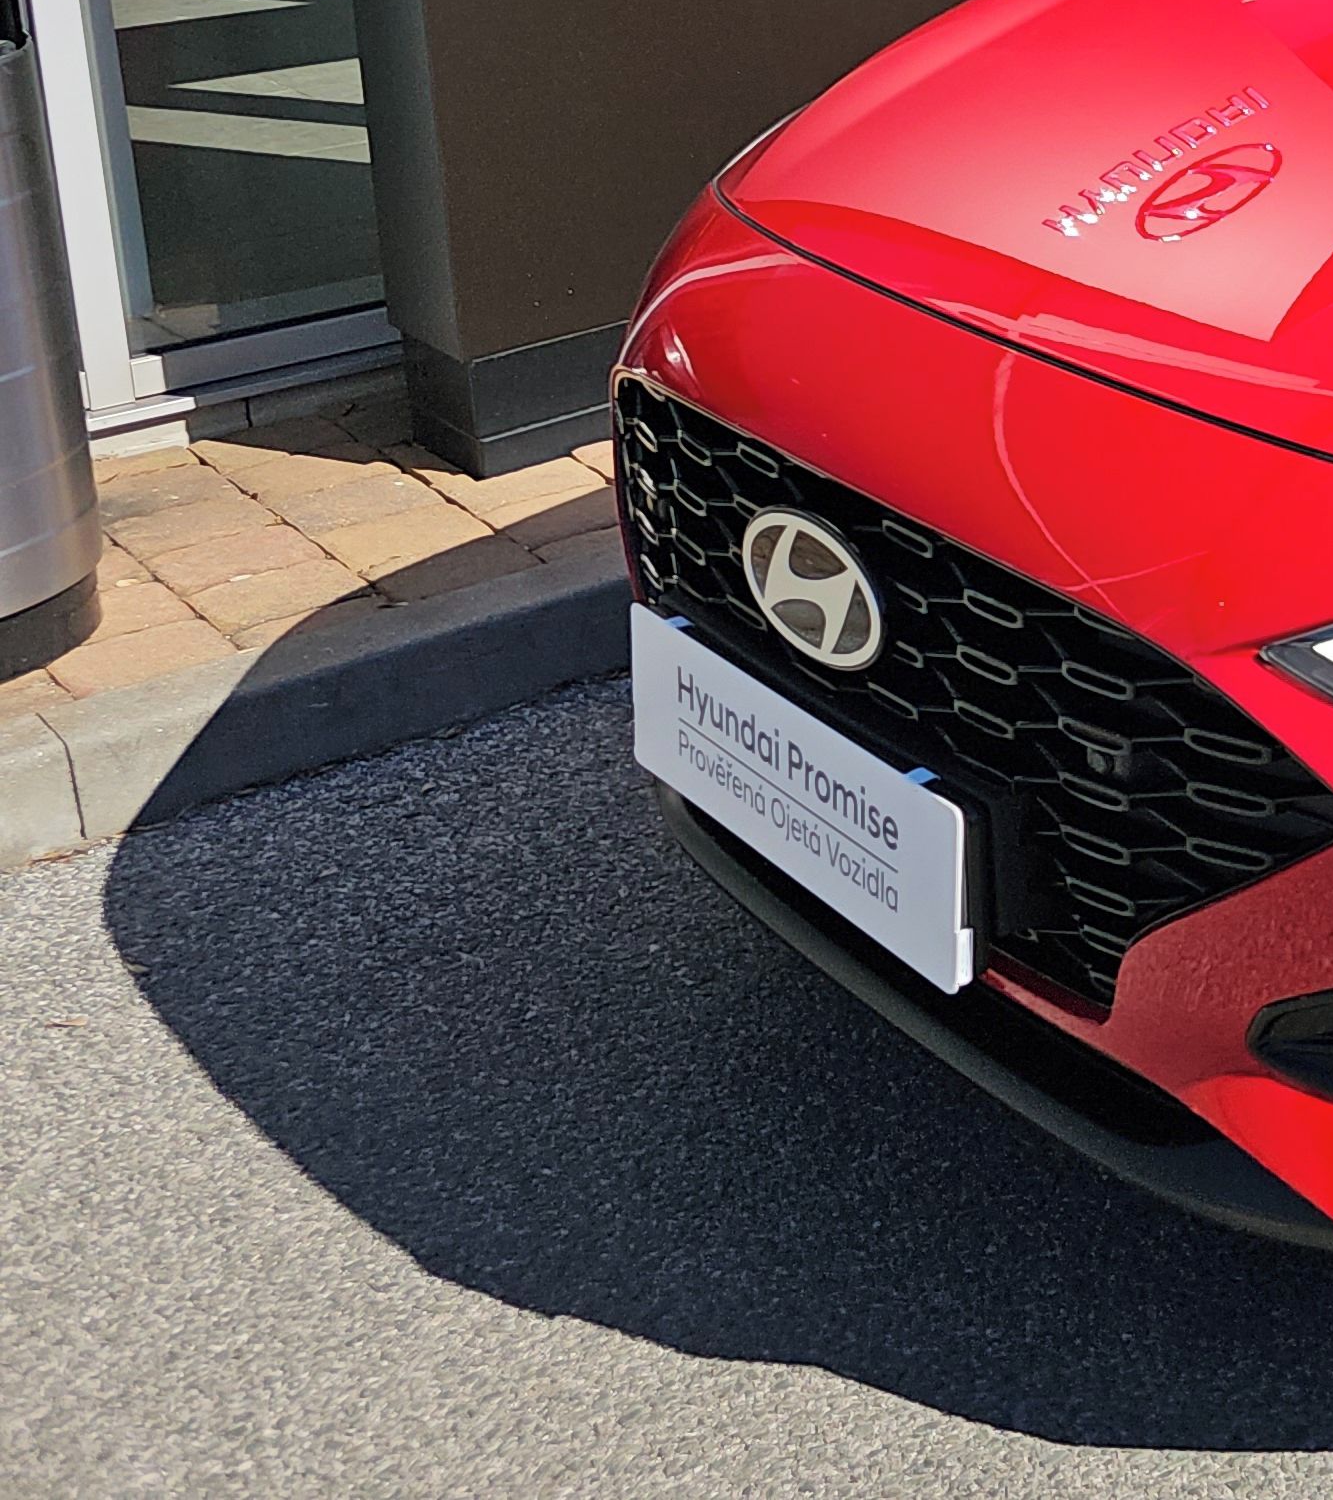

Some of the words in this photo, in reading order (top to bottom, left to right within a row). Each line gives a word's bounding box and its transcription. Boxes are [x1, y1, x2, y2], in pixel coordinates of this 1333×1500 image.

[676, 666, 781, 771] Hyundai
[788, 737, 900, 852] Promise
[677, 727, 767, 818] Prověřená
[770, 796, 822, 858] Ojetá
[826, 833, 899, 914] Vozidla
